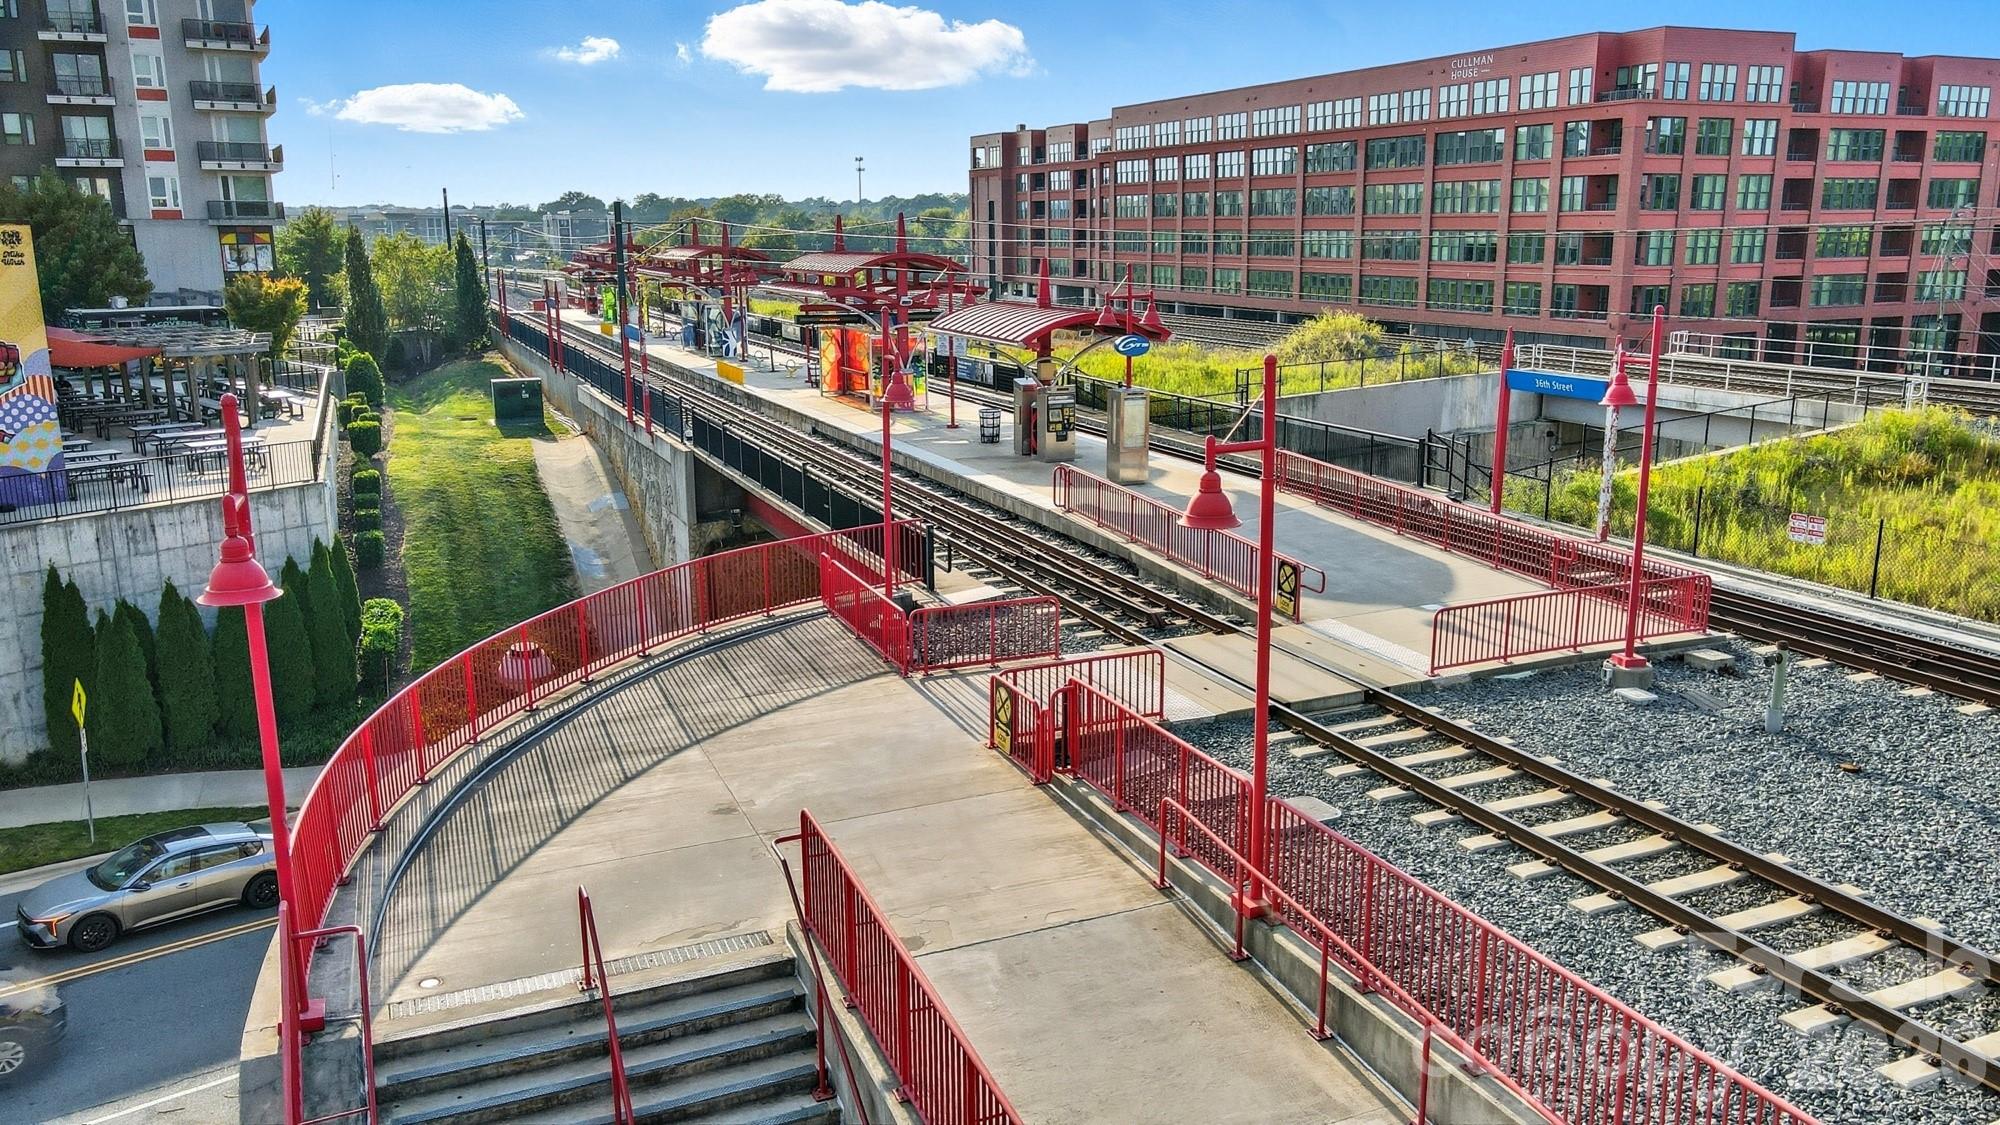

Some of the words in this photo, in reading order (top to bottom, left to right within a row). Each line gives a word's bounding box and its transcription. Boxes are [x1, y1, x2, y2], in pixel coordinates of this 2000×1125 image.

[1451, 54, 1494, 68] CULLMAN
[1451, 68, 1479, 80] HOUSE
[1535, 378, 1551, 389] 36th
[1552, 381, 1574, 392] Street
